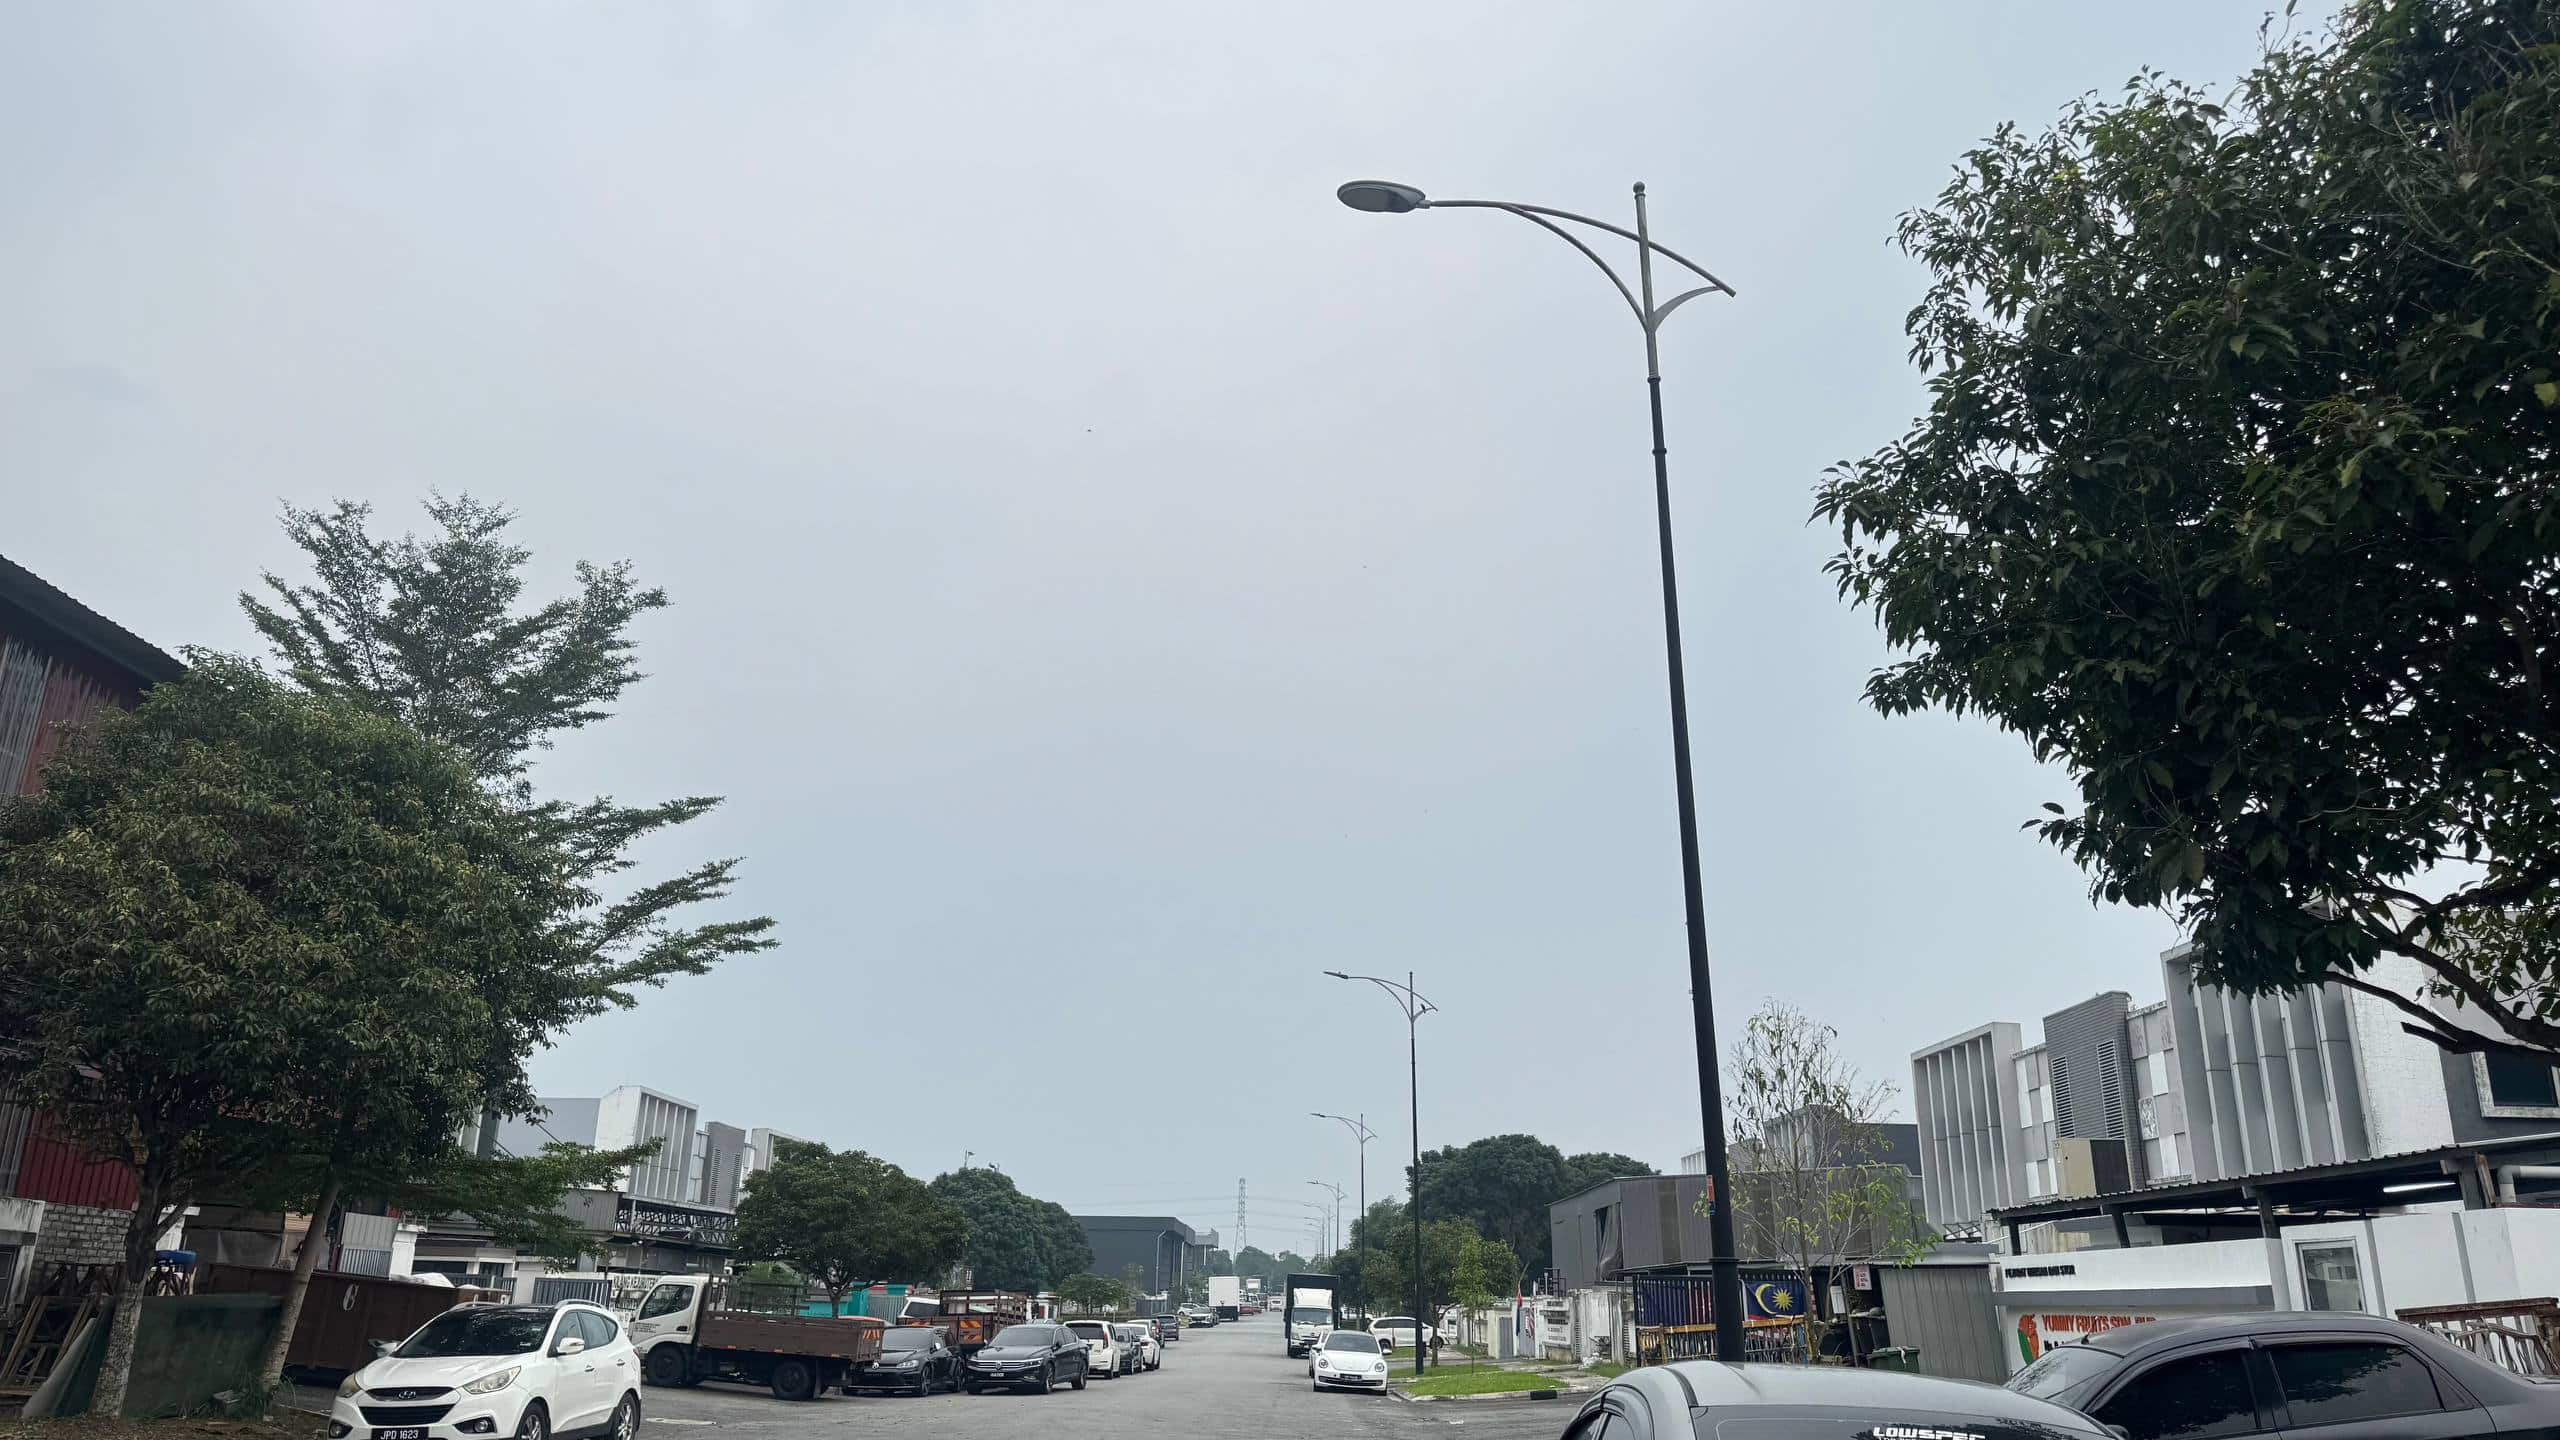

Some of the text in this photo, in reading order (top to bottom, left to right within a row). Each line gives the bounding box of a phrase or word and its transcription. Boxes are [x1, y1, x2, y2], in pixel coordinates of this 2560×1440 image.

[2042, 1314, 2074, 1331] YUMMY
[2075, 1315, 2110, 1333] FRUITS
[380, 1430, 397, 1440] JPD
